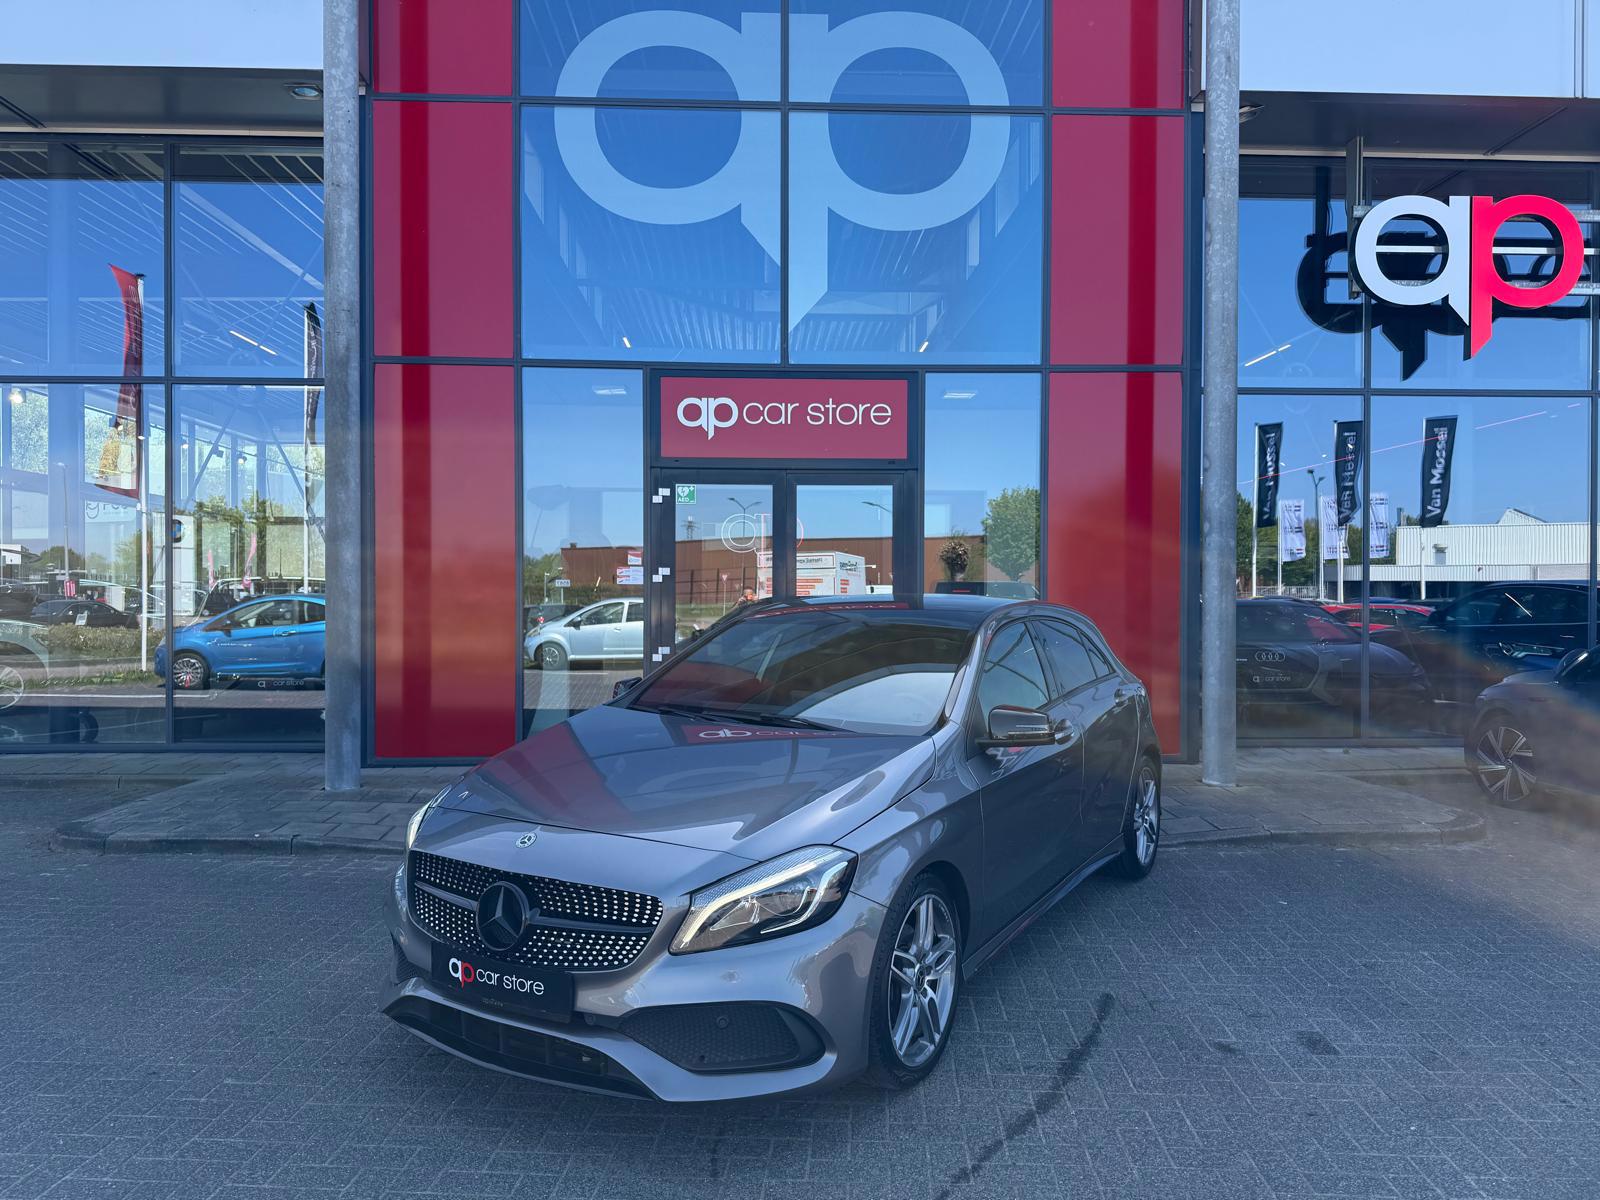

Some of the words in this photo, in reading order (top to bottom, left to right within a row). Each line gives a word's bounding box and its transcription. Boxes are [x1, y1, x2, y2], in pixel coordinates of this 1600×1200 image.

[743, 402, 799, 424] car
[806, 398, 892, 425] store
[1430, 426, 1448, 485] Mossel
[1426, 489, 1441, 518] Van
[476, 968, 500, 986] car
[503, 974, 544, 995] store
